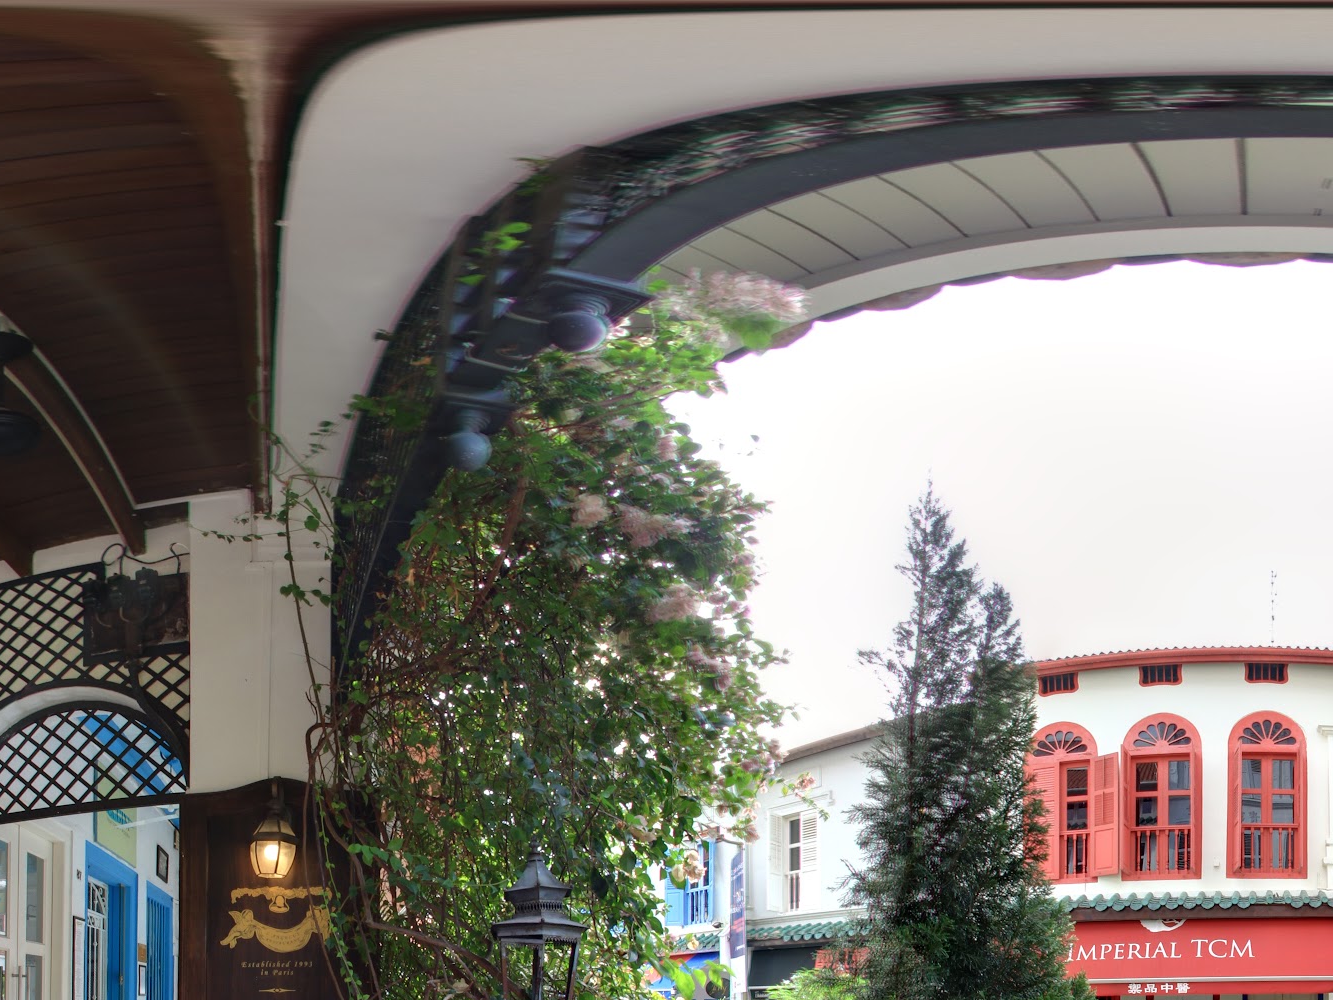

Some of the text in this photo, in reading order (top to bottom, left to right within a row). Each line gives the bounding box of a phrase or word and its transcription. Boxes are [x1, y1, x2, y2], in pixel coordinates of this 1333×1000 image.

[1065, 938, 1255, 962] IMPERIAL TCM
[241, 960, 290, 968] Established
[260, 968, 269, 976] in
